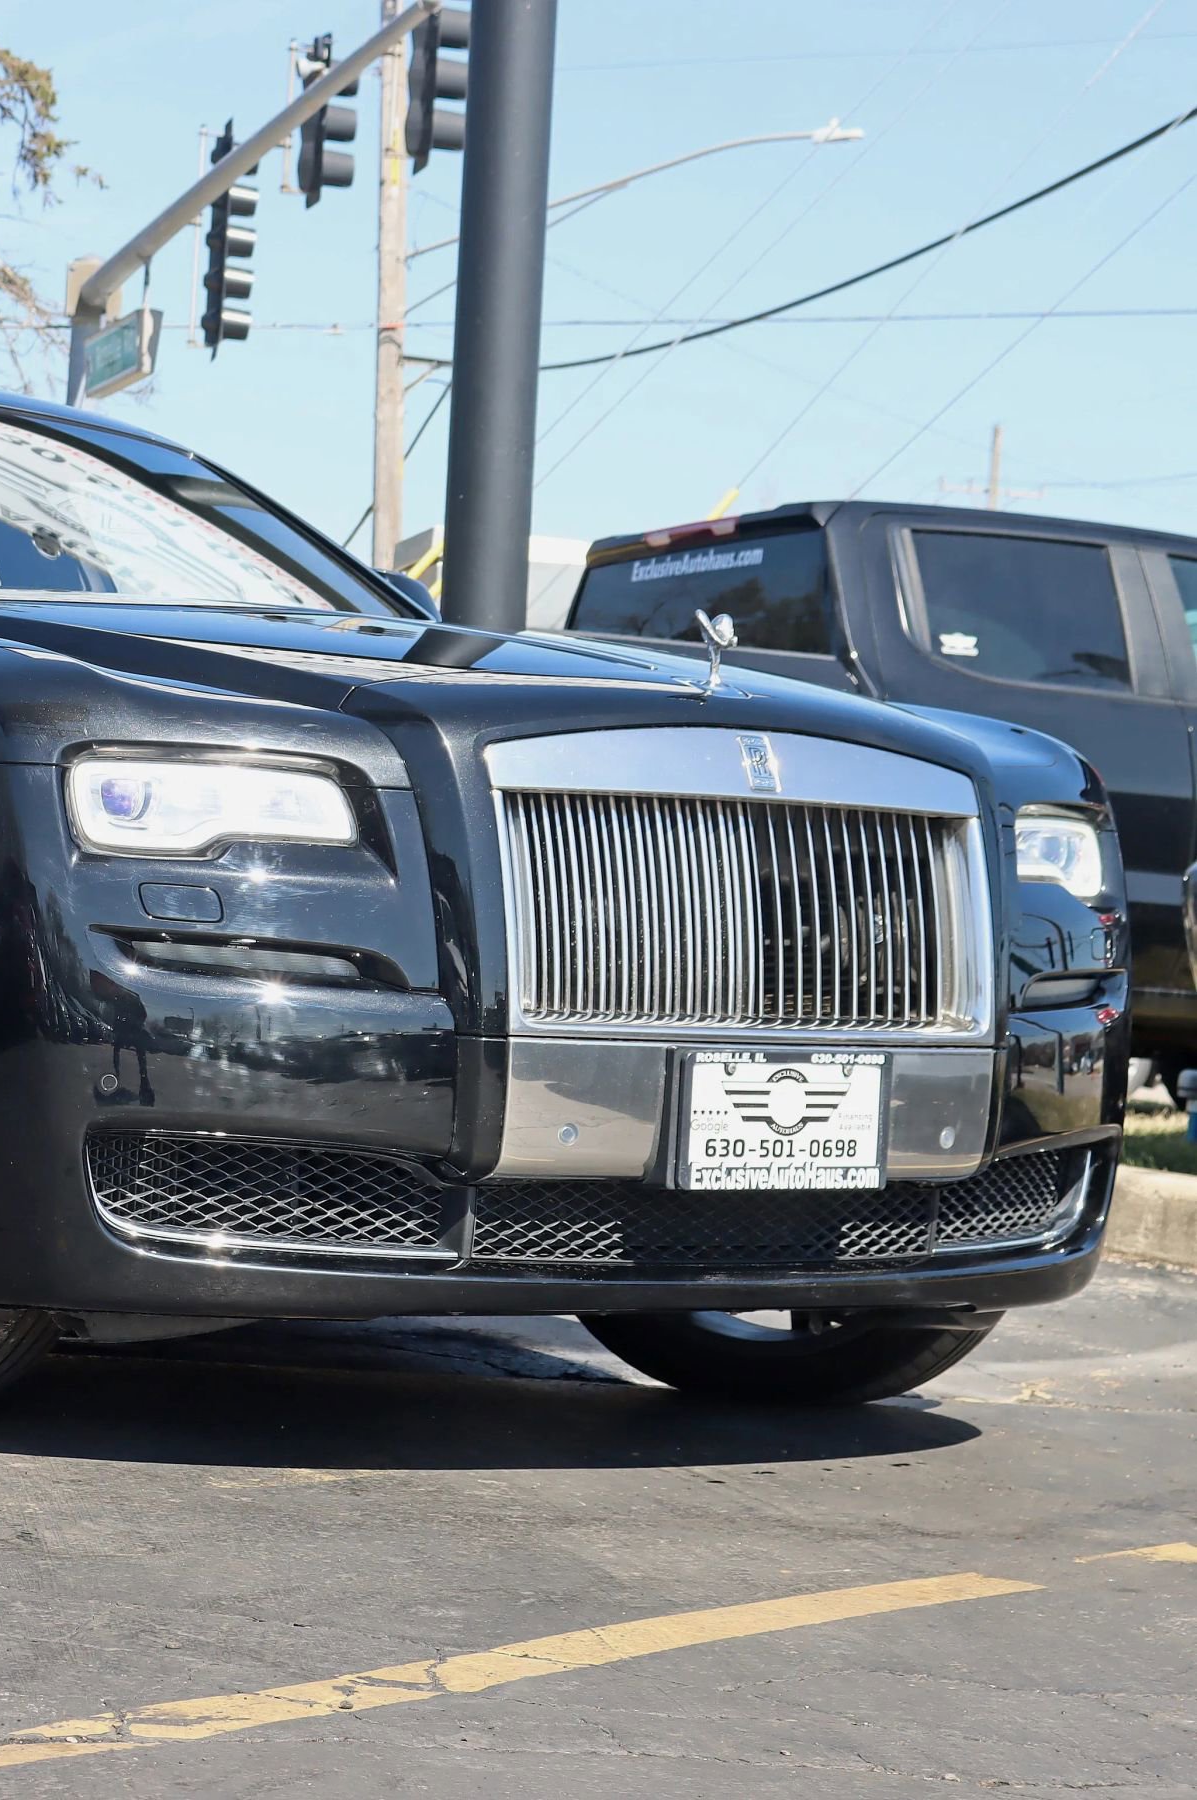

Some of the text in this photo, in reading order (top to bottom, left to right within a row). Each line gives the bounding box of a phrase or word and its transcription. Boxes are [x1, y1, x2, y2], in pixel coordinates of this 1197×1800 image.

[632, 548, 763, 582] ExclusiveAutohaus.com
[696, 1052, 767, 1063] ROSELLE, IL
[771, 1123, 804, 1135] AUTOHAUS
[705, 1138, 858, 1158] 630-501-0698
[689, 1162, 880, 1190] ExclusiveAutoHaus.com
